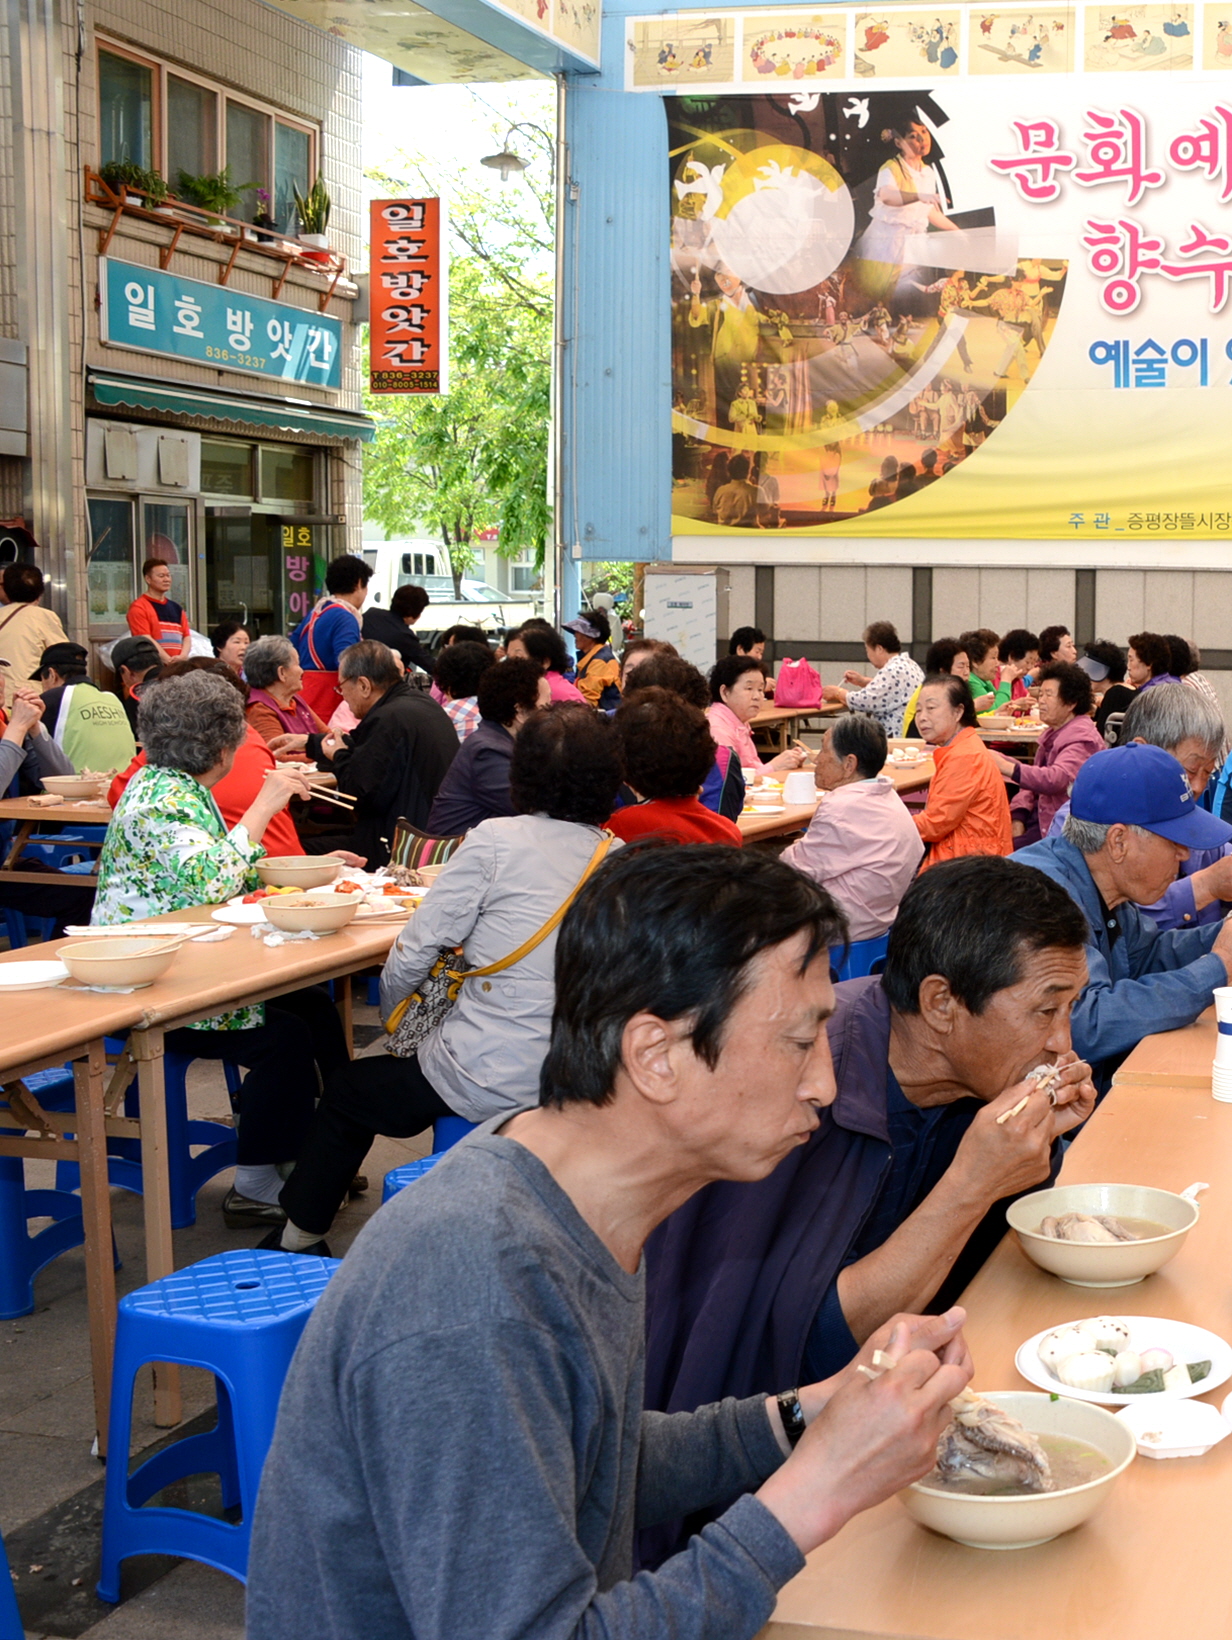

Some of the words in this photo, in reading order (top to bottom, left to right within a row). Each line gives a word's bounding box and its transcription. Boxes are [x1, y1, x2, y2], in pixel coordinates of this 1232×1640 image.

[379, 201, 432, 367] 일호방앗간
[205, 345, 267, 370] 836-3237
[1088, 337, 1209, 389] 예술이
[372, 381, 438, 389] 010-8005-1514
